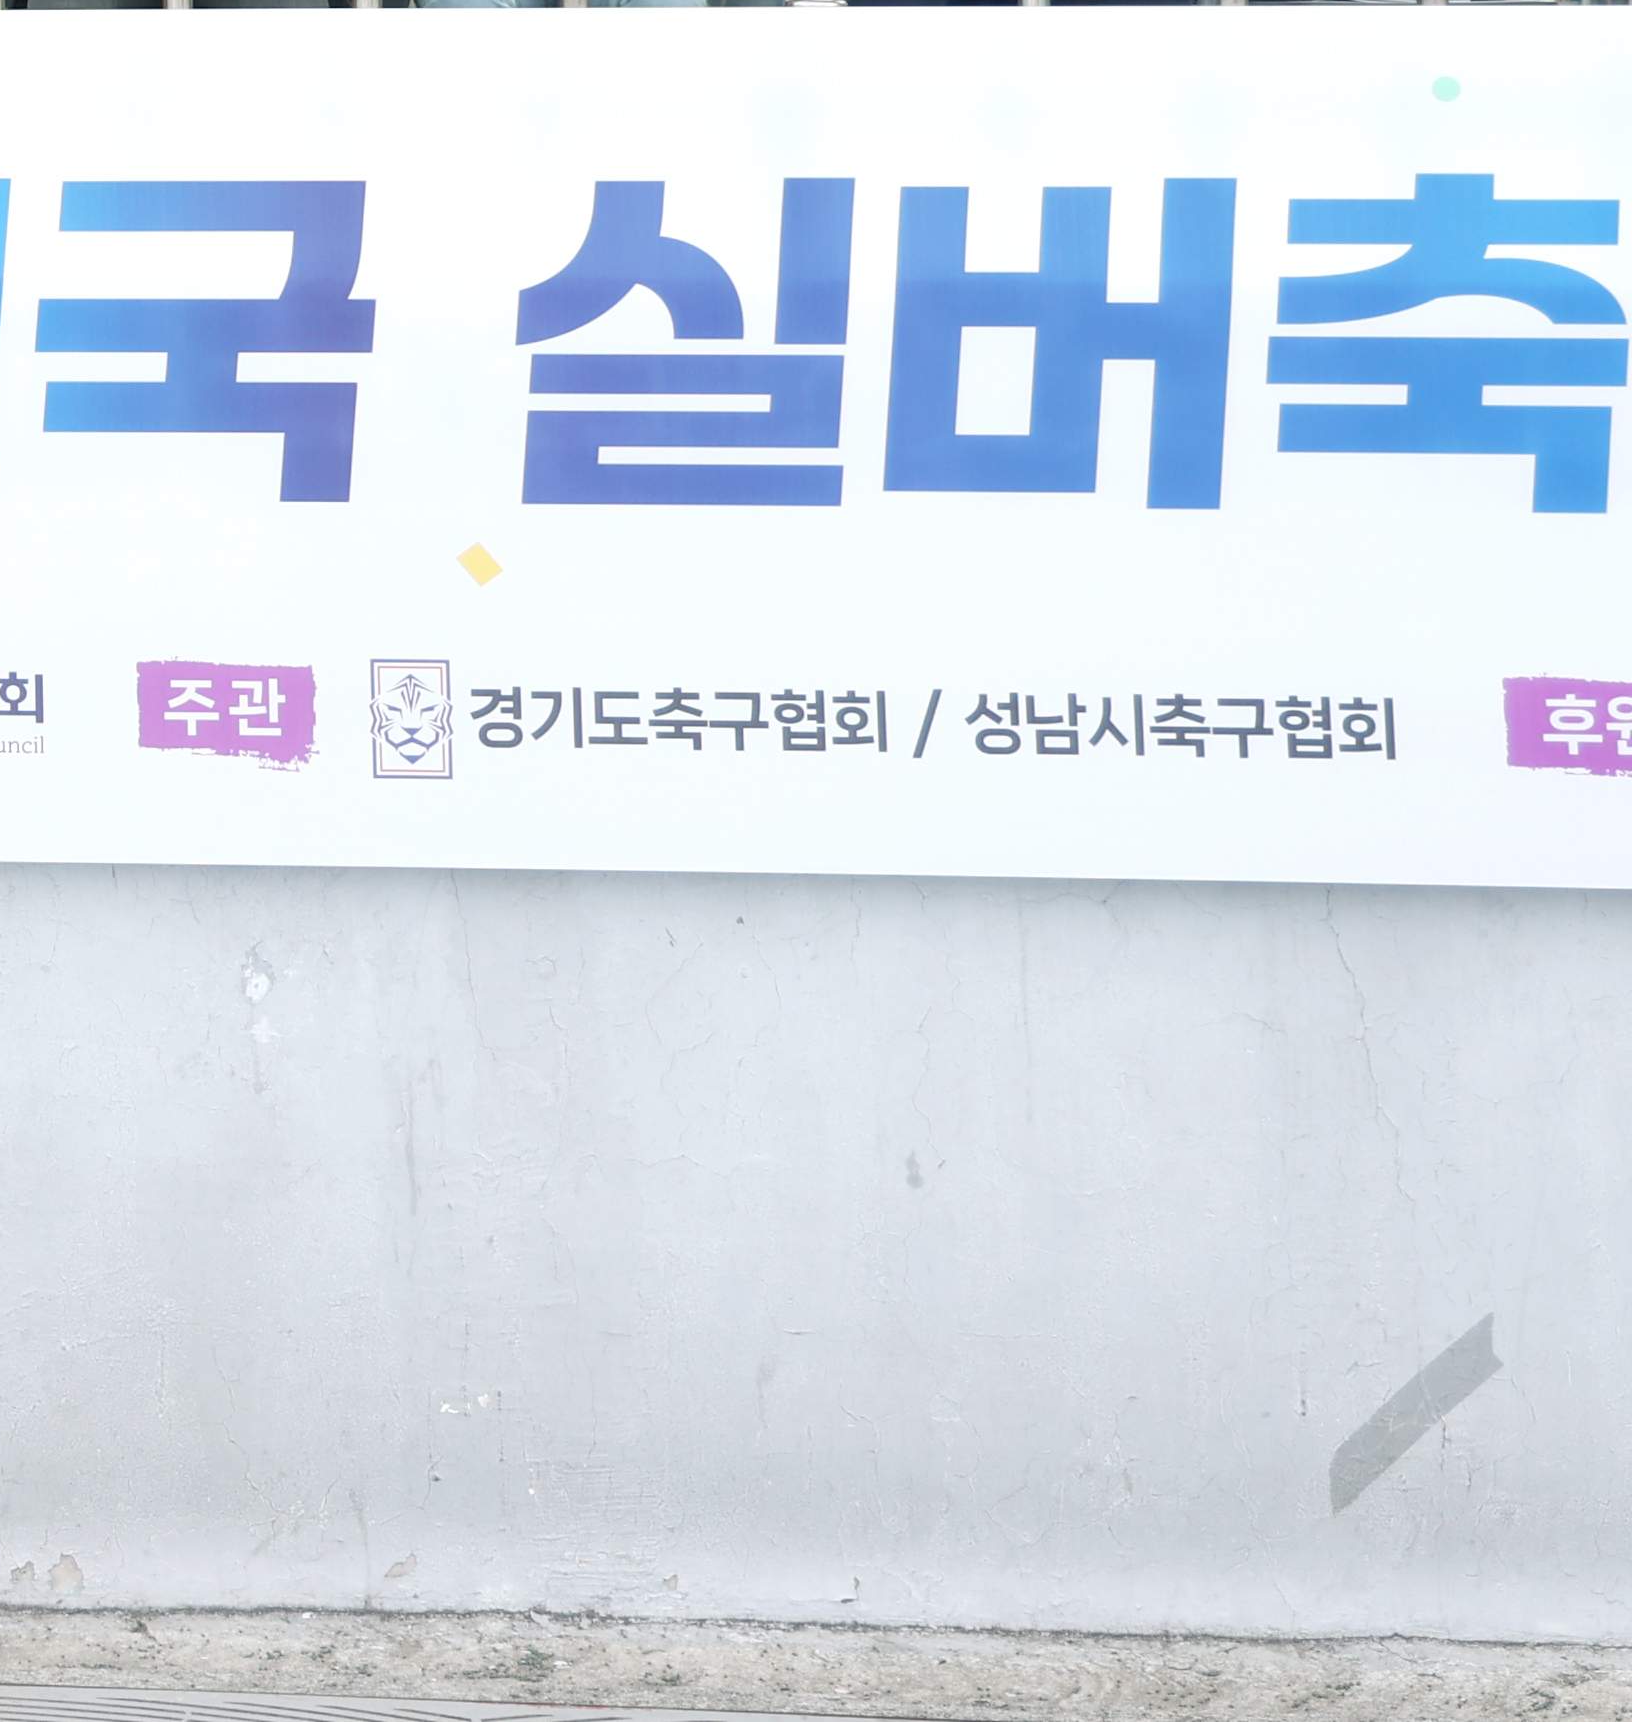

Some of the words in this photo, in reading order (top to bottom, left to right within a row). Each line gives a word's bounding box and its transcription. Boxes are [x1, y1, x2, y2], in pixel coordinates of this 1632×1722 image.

[515, 173, 1629, 515] 실버축
[163, 677, 287, 737] 주관
[469, 685, 889, 753] 경기도축구협회
[964, 691, 1397, 761] 성남시축구협회
